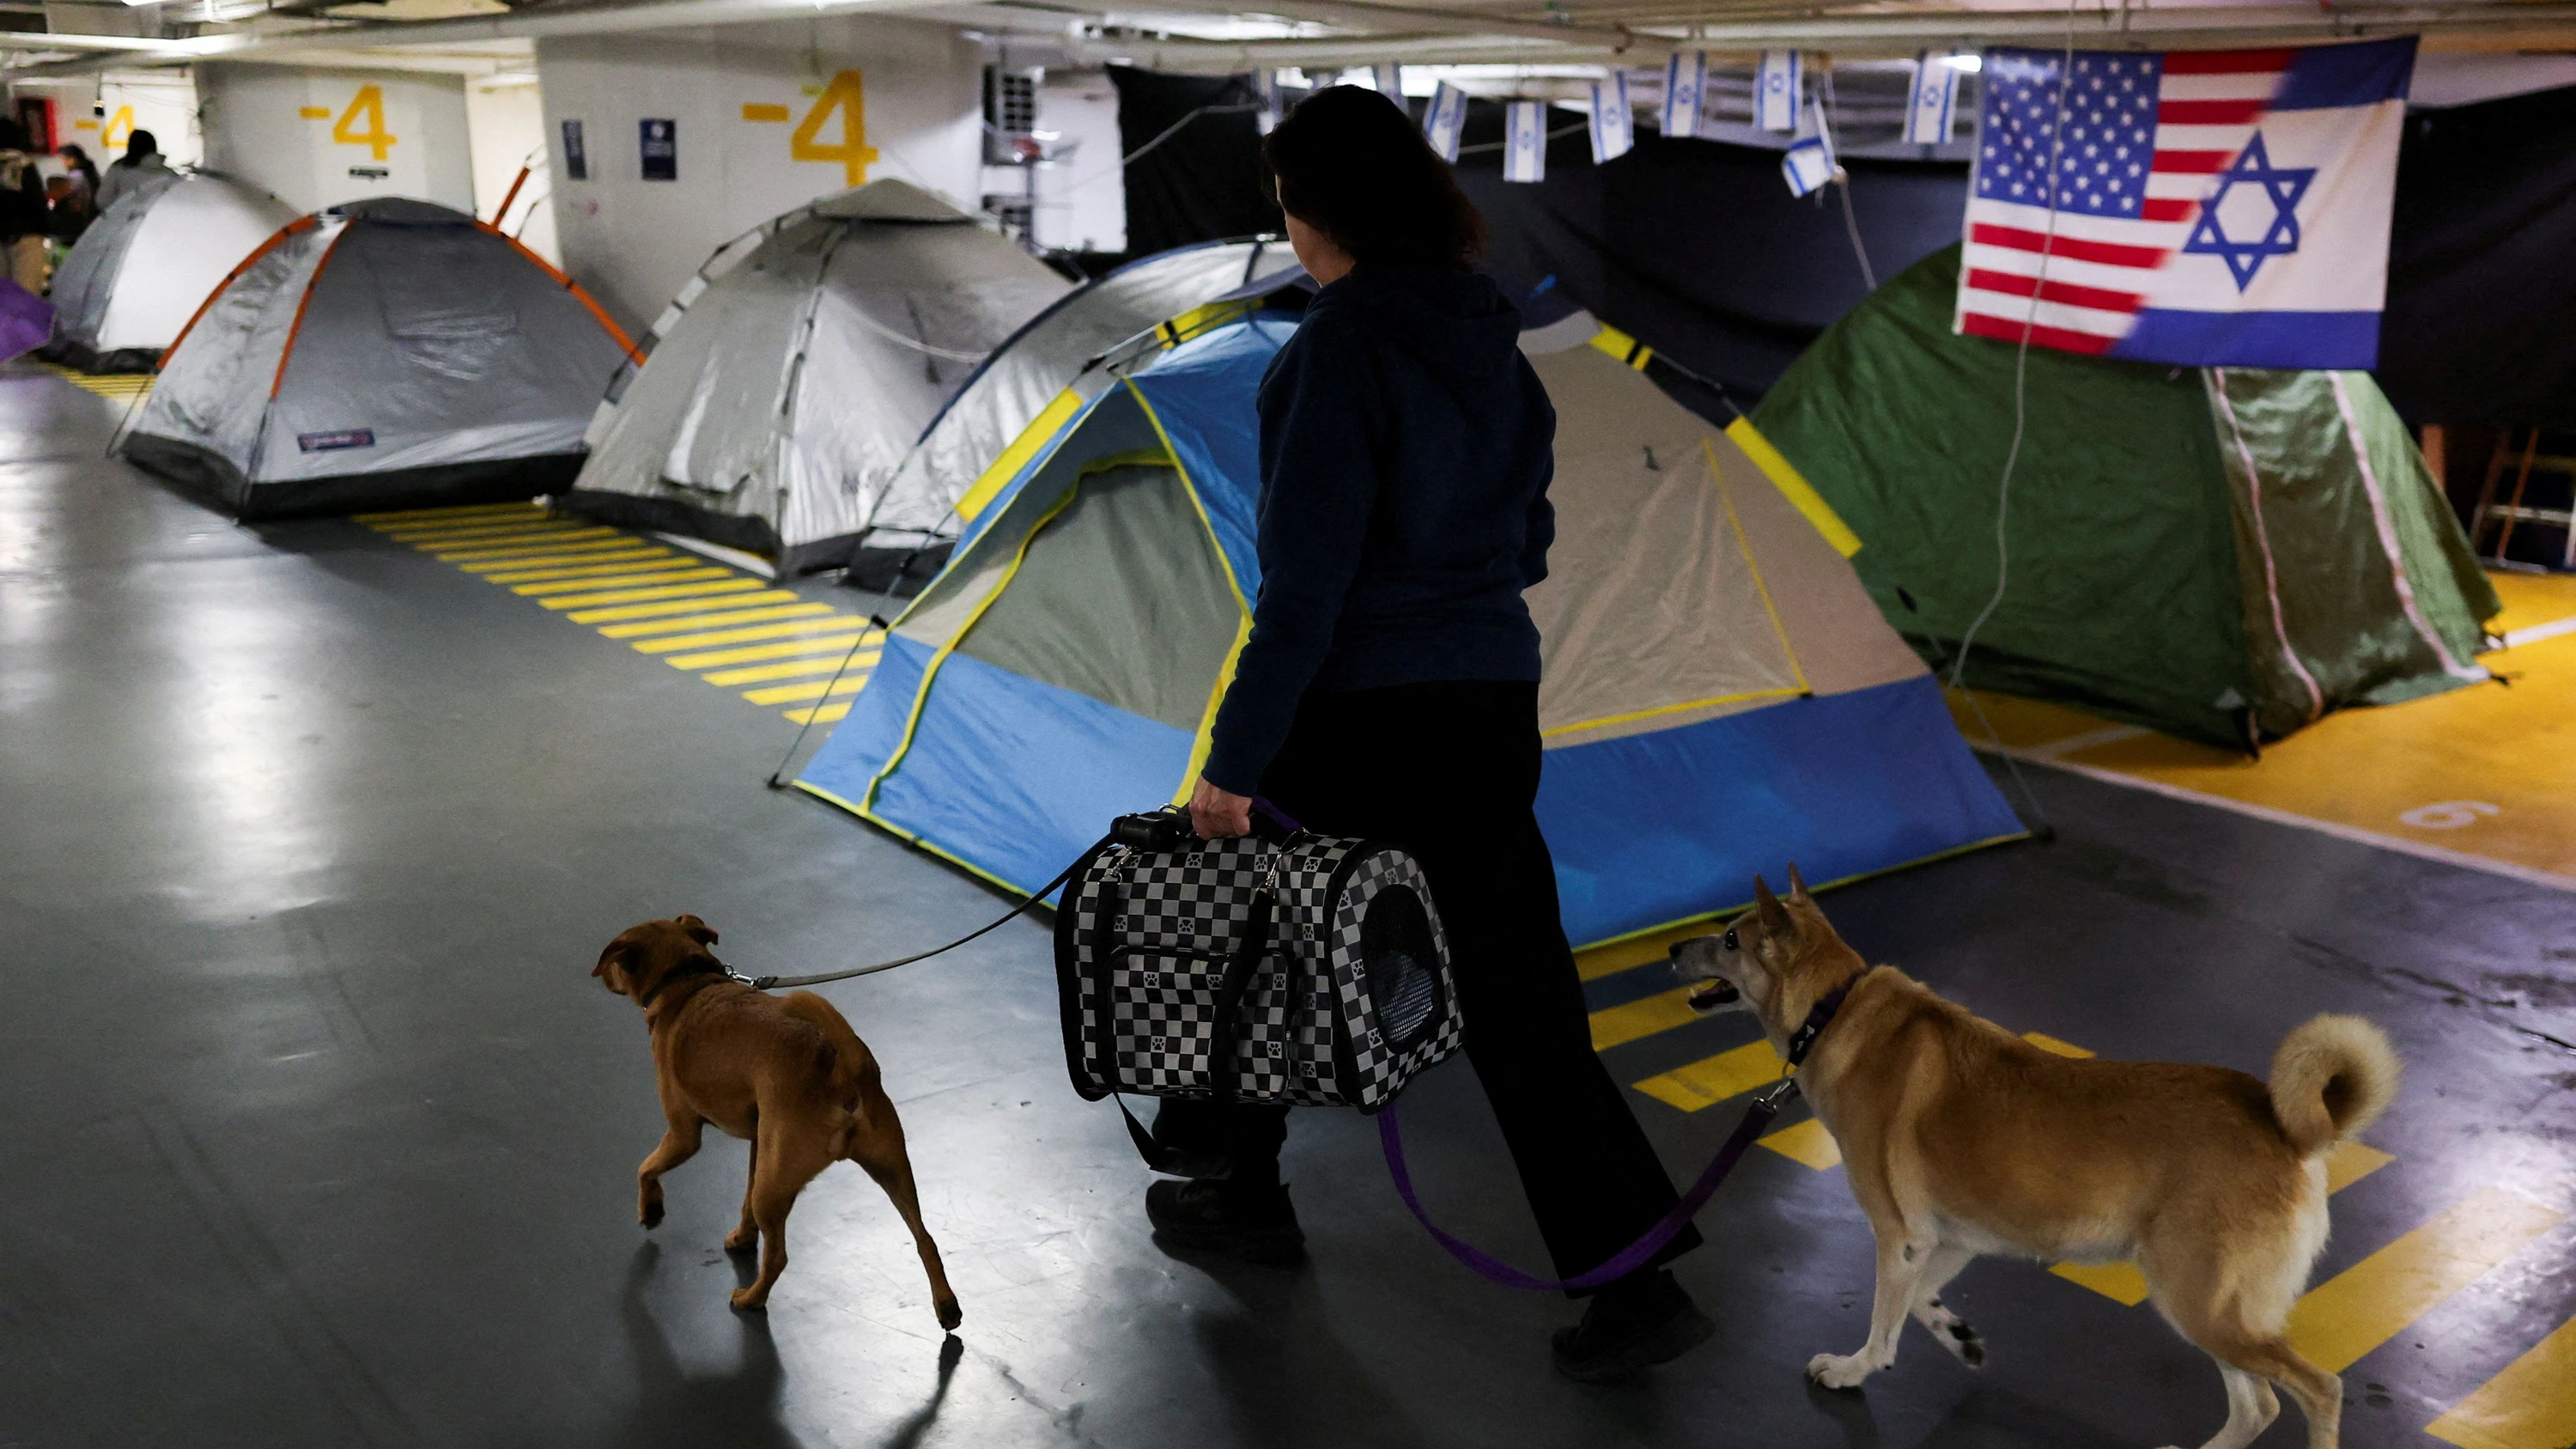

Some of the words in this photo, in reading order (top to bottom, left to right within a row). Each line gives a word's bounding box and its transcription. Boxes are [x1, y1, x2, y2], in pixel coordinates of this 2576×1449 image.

[298, 85, 398, 161] -4
[742, 68, 879, 189] -4
[2398, 800, 2500, 830] 6
